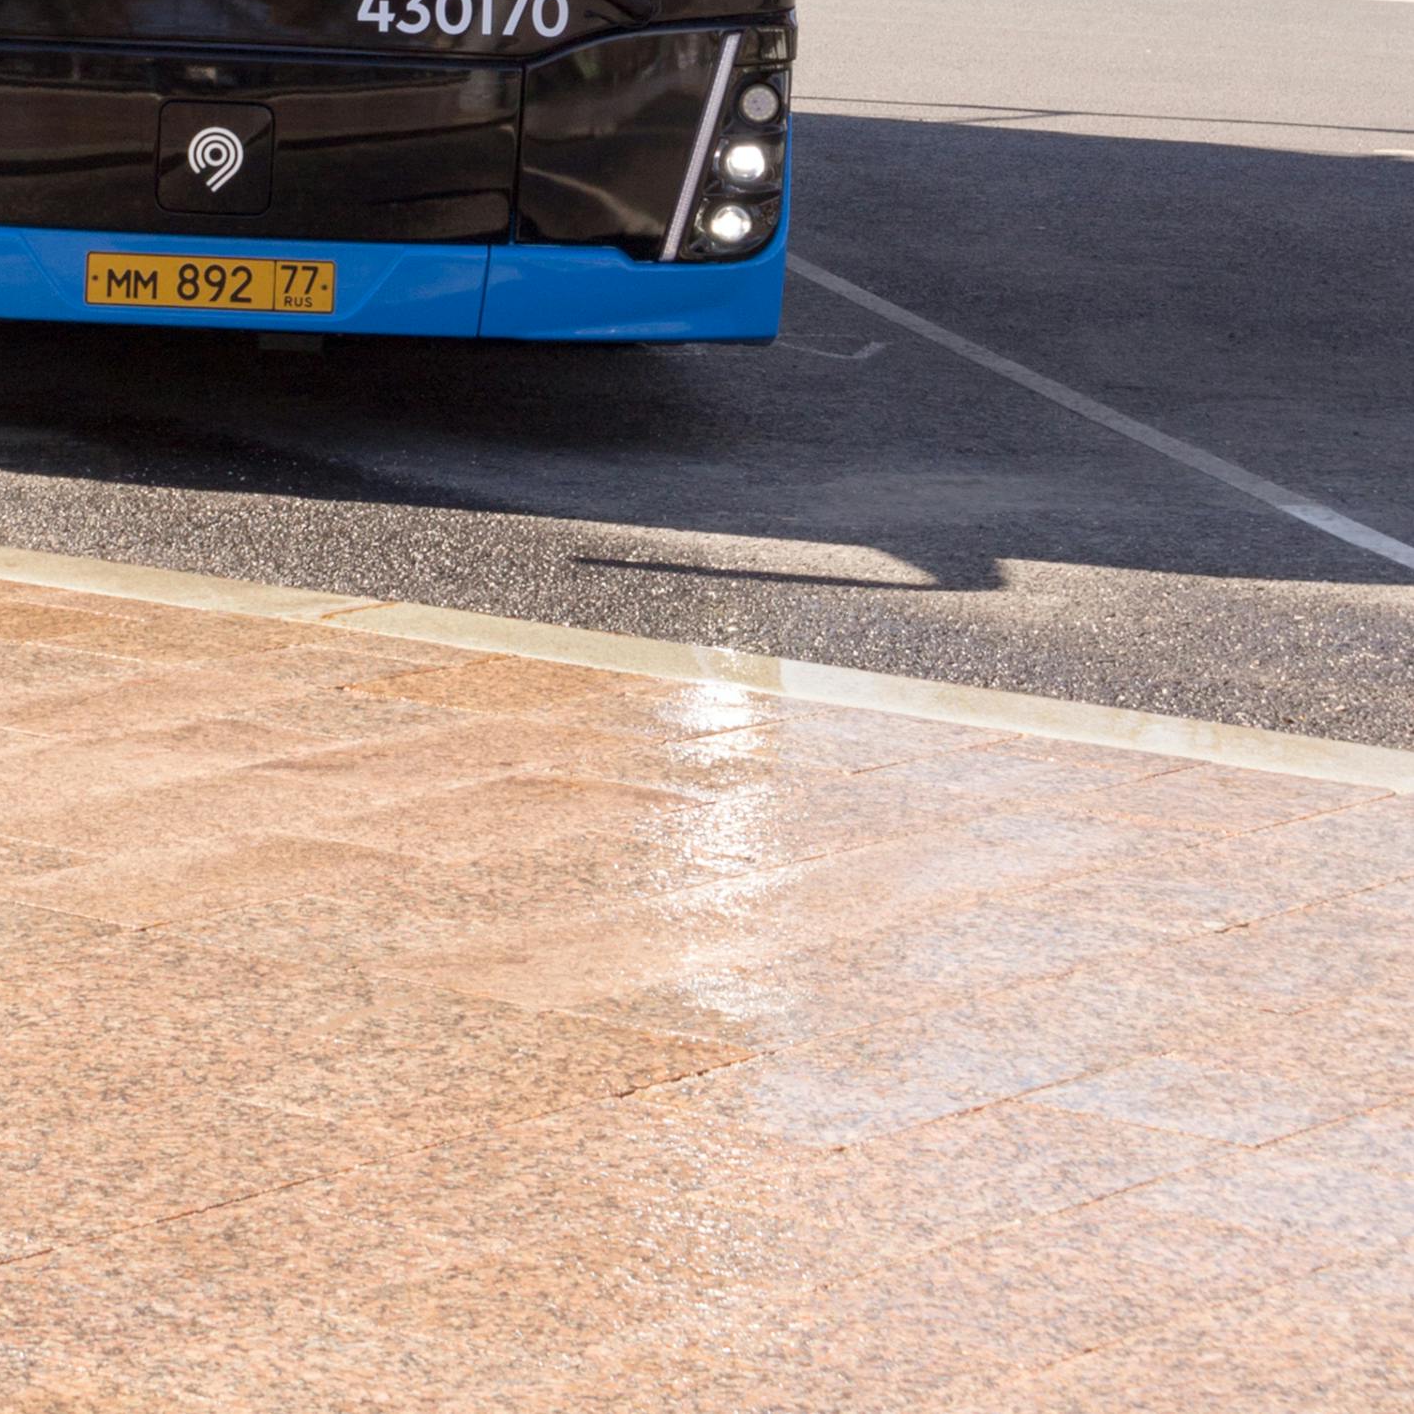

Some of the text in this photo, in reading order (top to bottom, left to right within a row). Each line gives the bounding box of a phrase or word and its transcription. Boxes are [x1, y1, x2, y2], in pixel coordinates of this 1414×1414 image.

[176, 263, 253, 303] 892
[280, 265, 319, 295] 77
[284, 296, 313, 308] RUS
